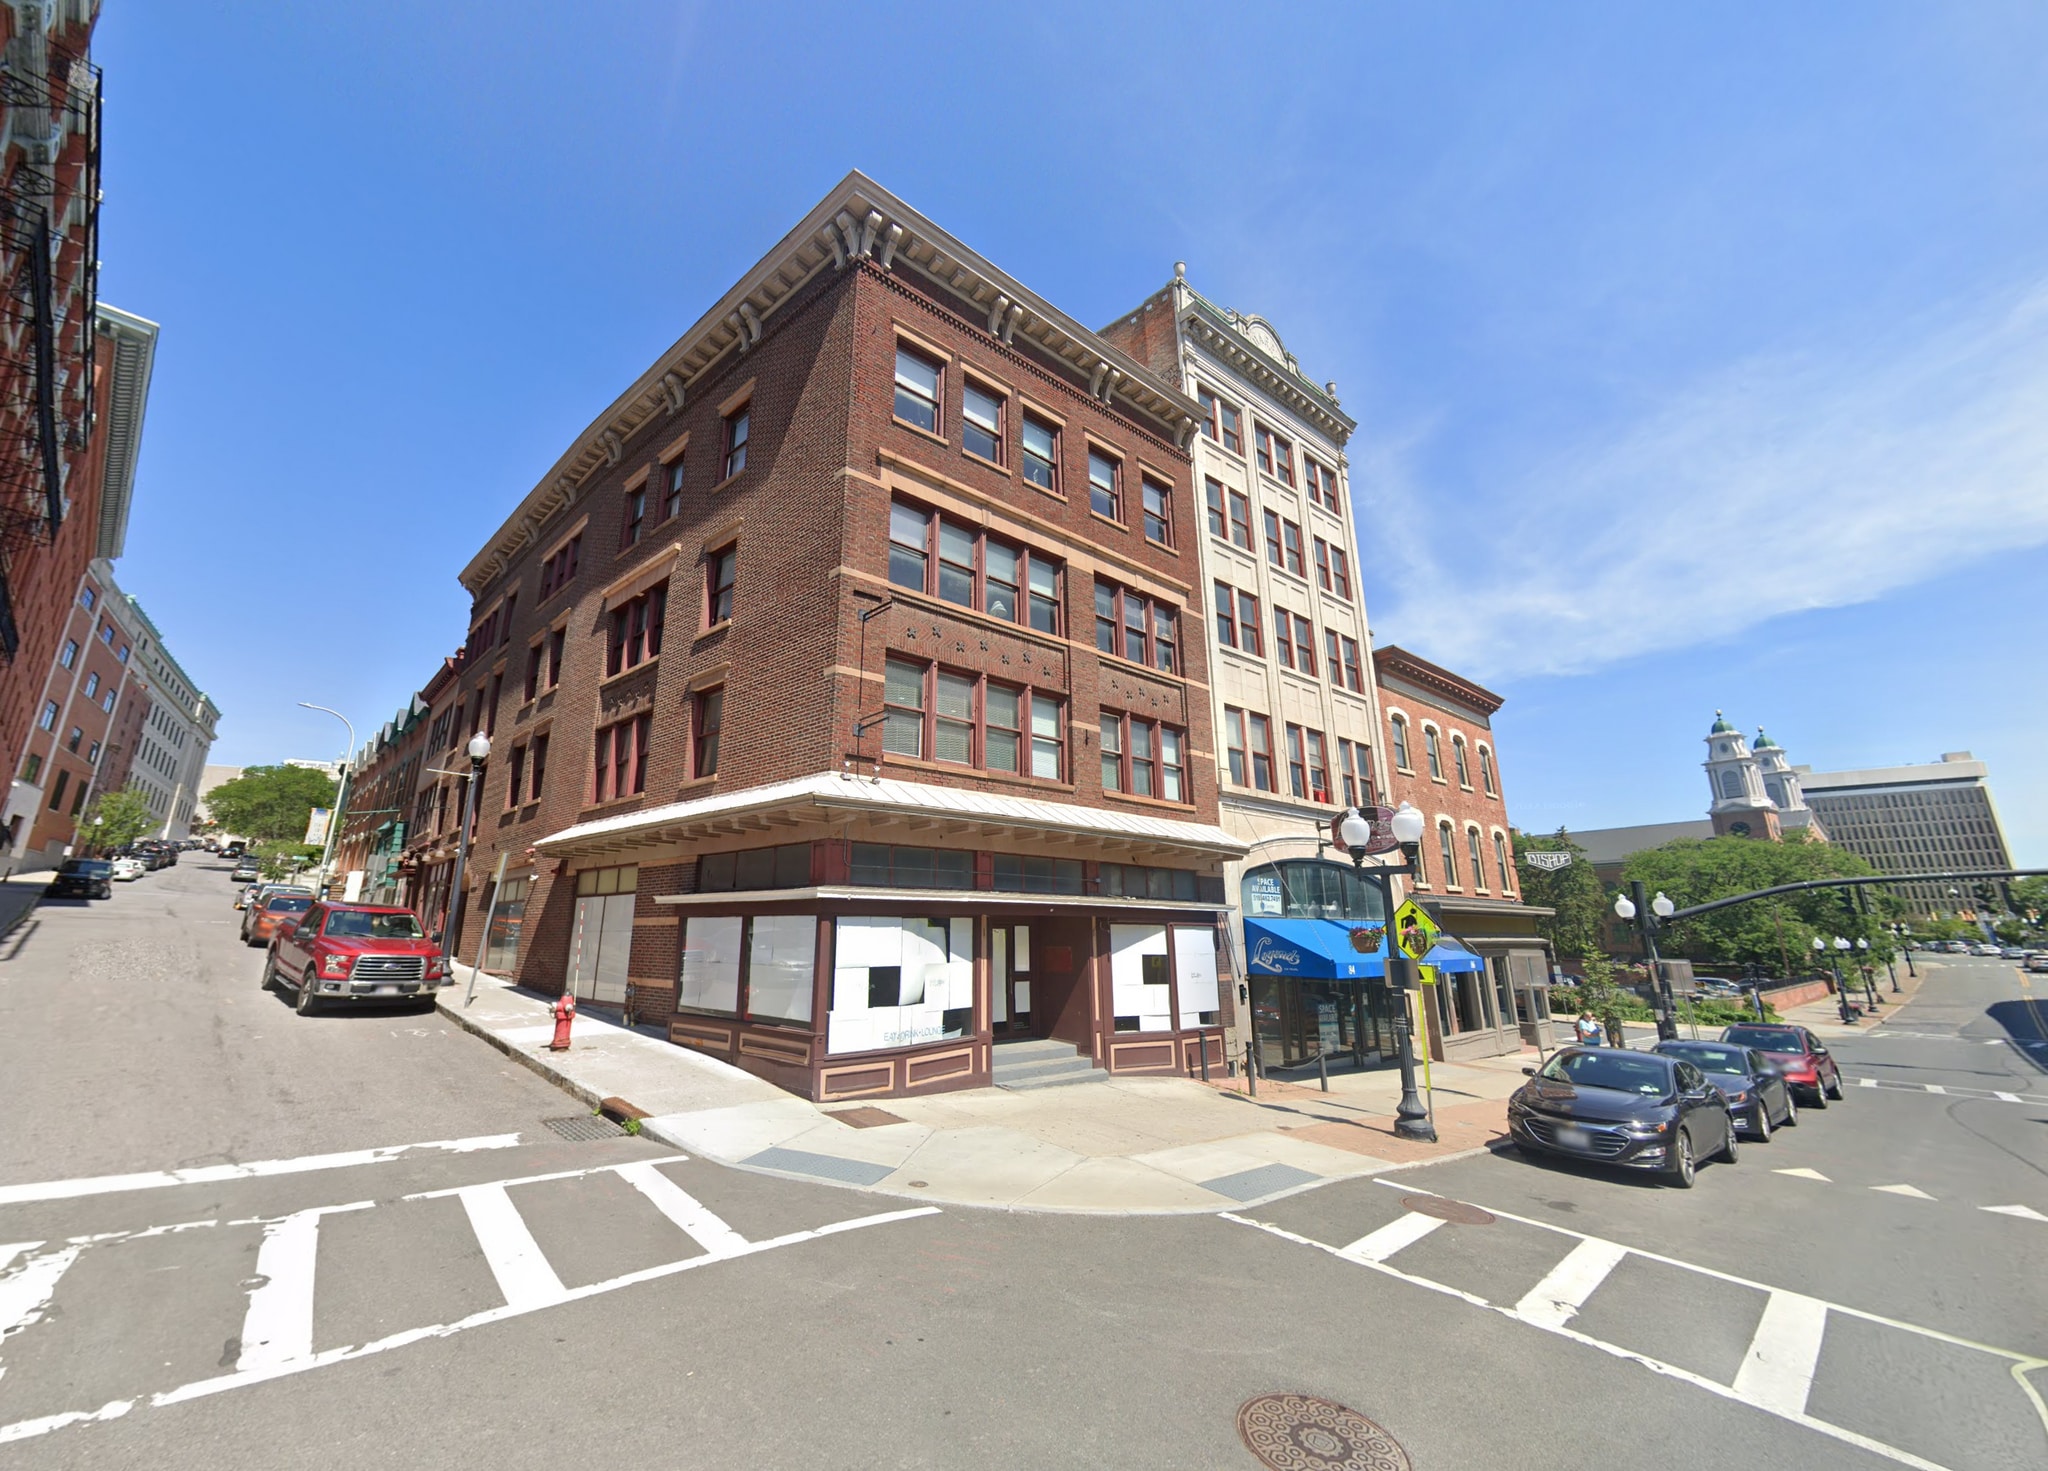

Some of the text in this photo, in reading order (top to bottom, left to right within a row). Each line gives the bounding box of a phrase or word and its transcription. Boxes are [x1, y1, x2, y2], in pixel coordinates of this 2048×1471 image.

[1251, 885, 1281, 894] AVAILABLE
[1250, 936, 1300, 973] Legends
[1348, 964, 1356, 975] 84
